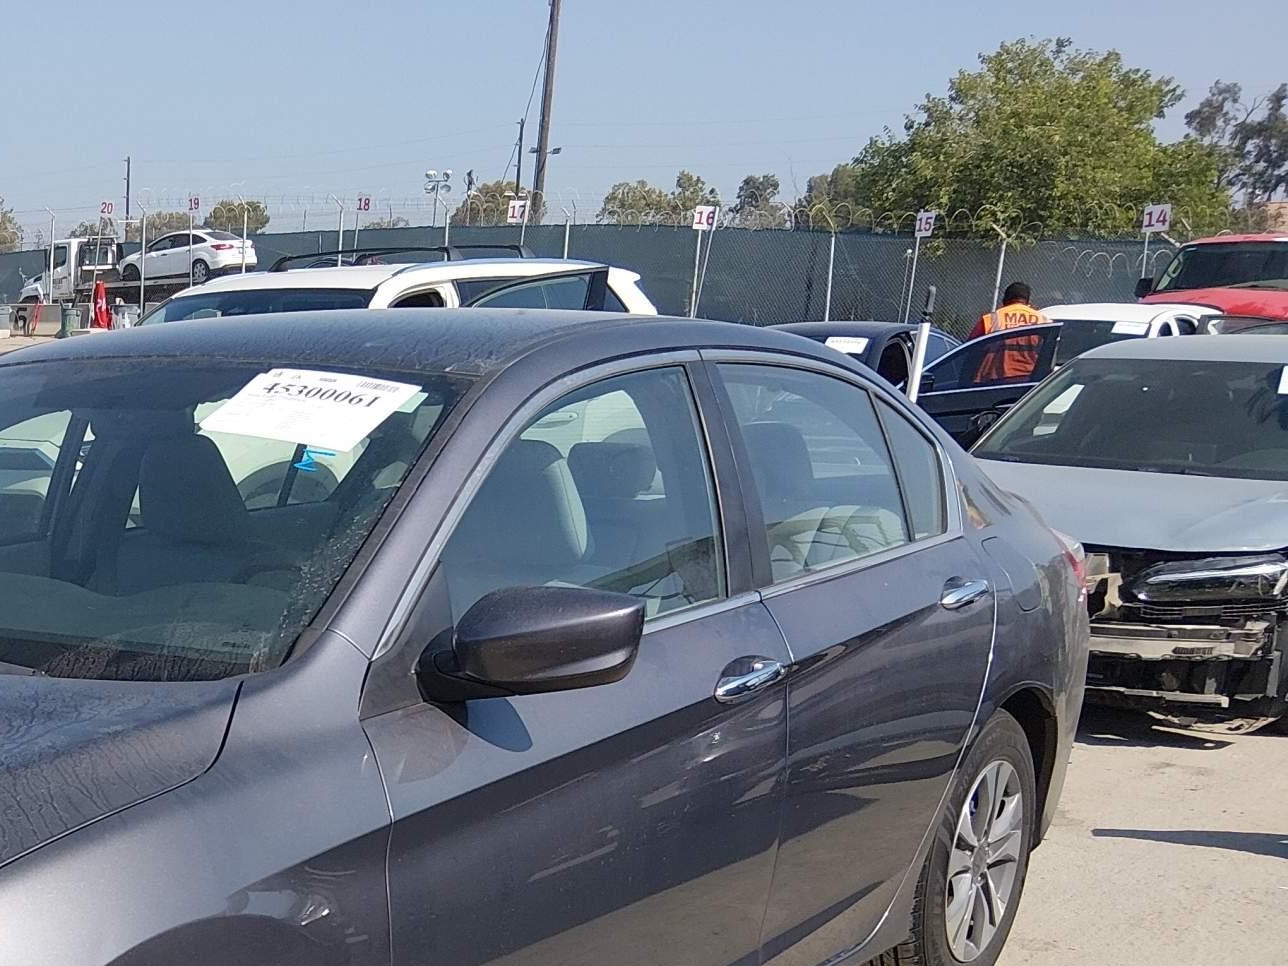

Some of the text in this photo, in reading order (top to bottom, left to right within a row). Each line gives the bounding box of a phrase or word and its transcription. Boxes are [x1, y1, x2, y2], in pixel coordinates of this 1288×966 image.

[100, 201, 113, 214] 20
[188, 197, 200, 211] 19
[356, 197, 370, 211] 18
[508, 204, 527, 219] 17
[695, 210, 715, 226] 16
[916, 216, 934, 233] 15
[1144, 208, 1168, 228] 14
[263, 382, 382, 408] 45300061
